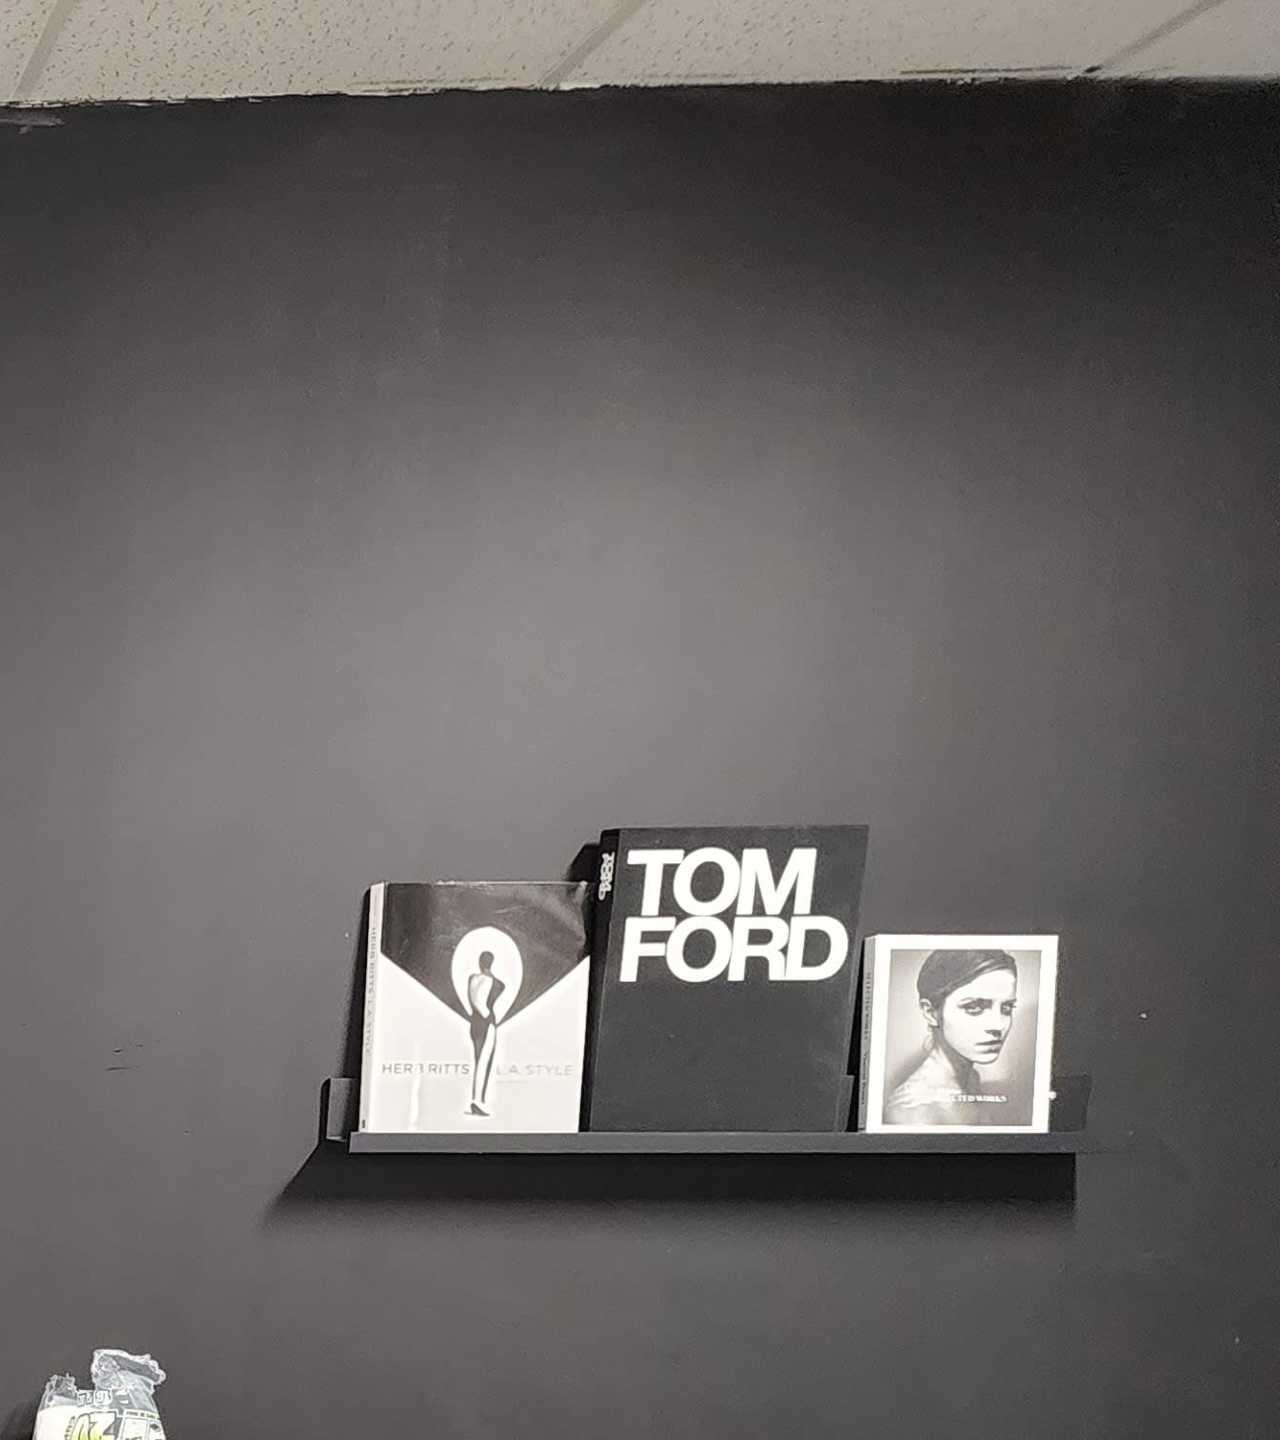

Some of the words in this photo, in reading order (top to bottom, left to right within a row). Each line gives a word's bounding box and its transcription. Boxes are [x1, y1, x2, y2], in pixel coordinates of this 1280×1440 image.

[627, 847, 817, 916] TOM
[619, 915, 849, 983] FORD
[427, 1062, 470, 1075] RITTS
[525, 1063, 575, 1076] STYLE
